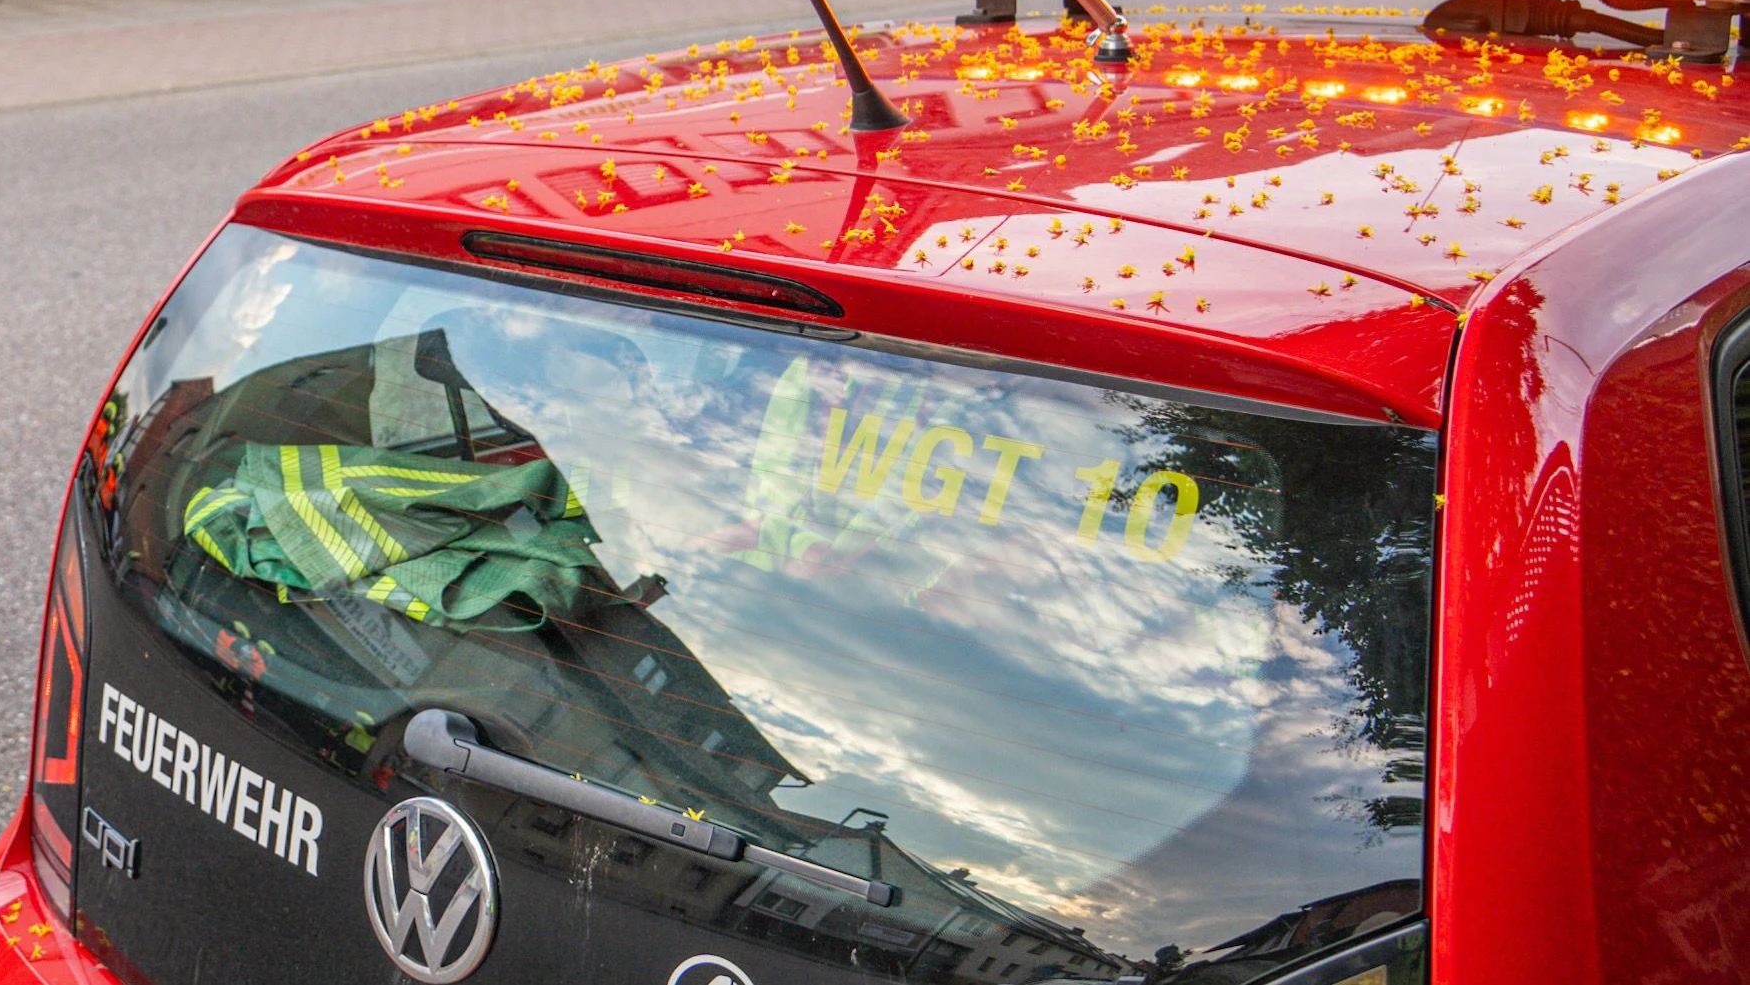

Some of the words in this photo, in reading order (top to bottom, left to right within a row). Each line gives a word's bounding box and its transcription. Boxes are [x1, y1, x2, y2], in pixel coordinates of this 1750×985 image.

[816, 407, 1046, 527] WGT
[1074, 458, 1200, 564] 10
[82, 807, 139, 879] up!
[99, 682, 323, 877] FEUERWEHR
